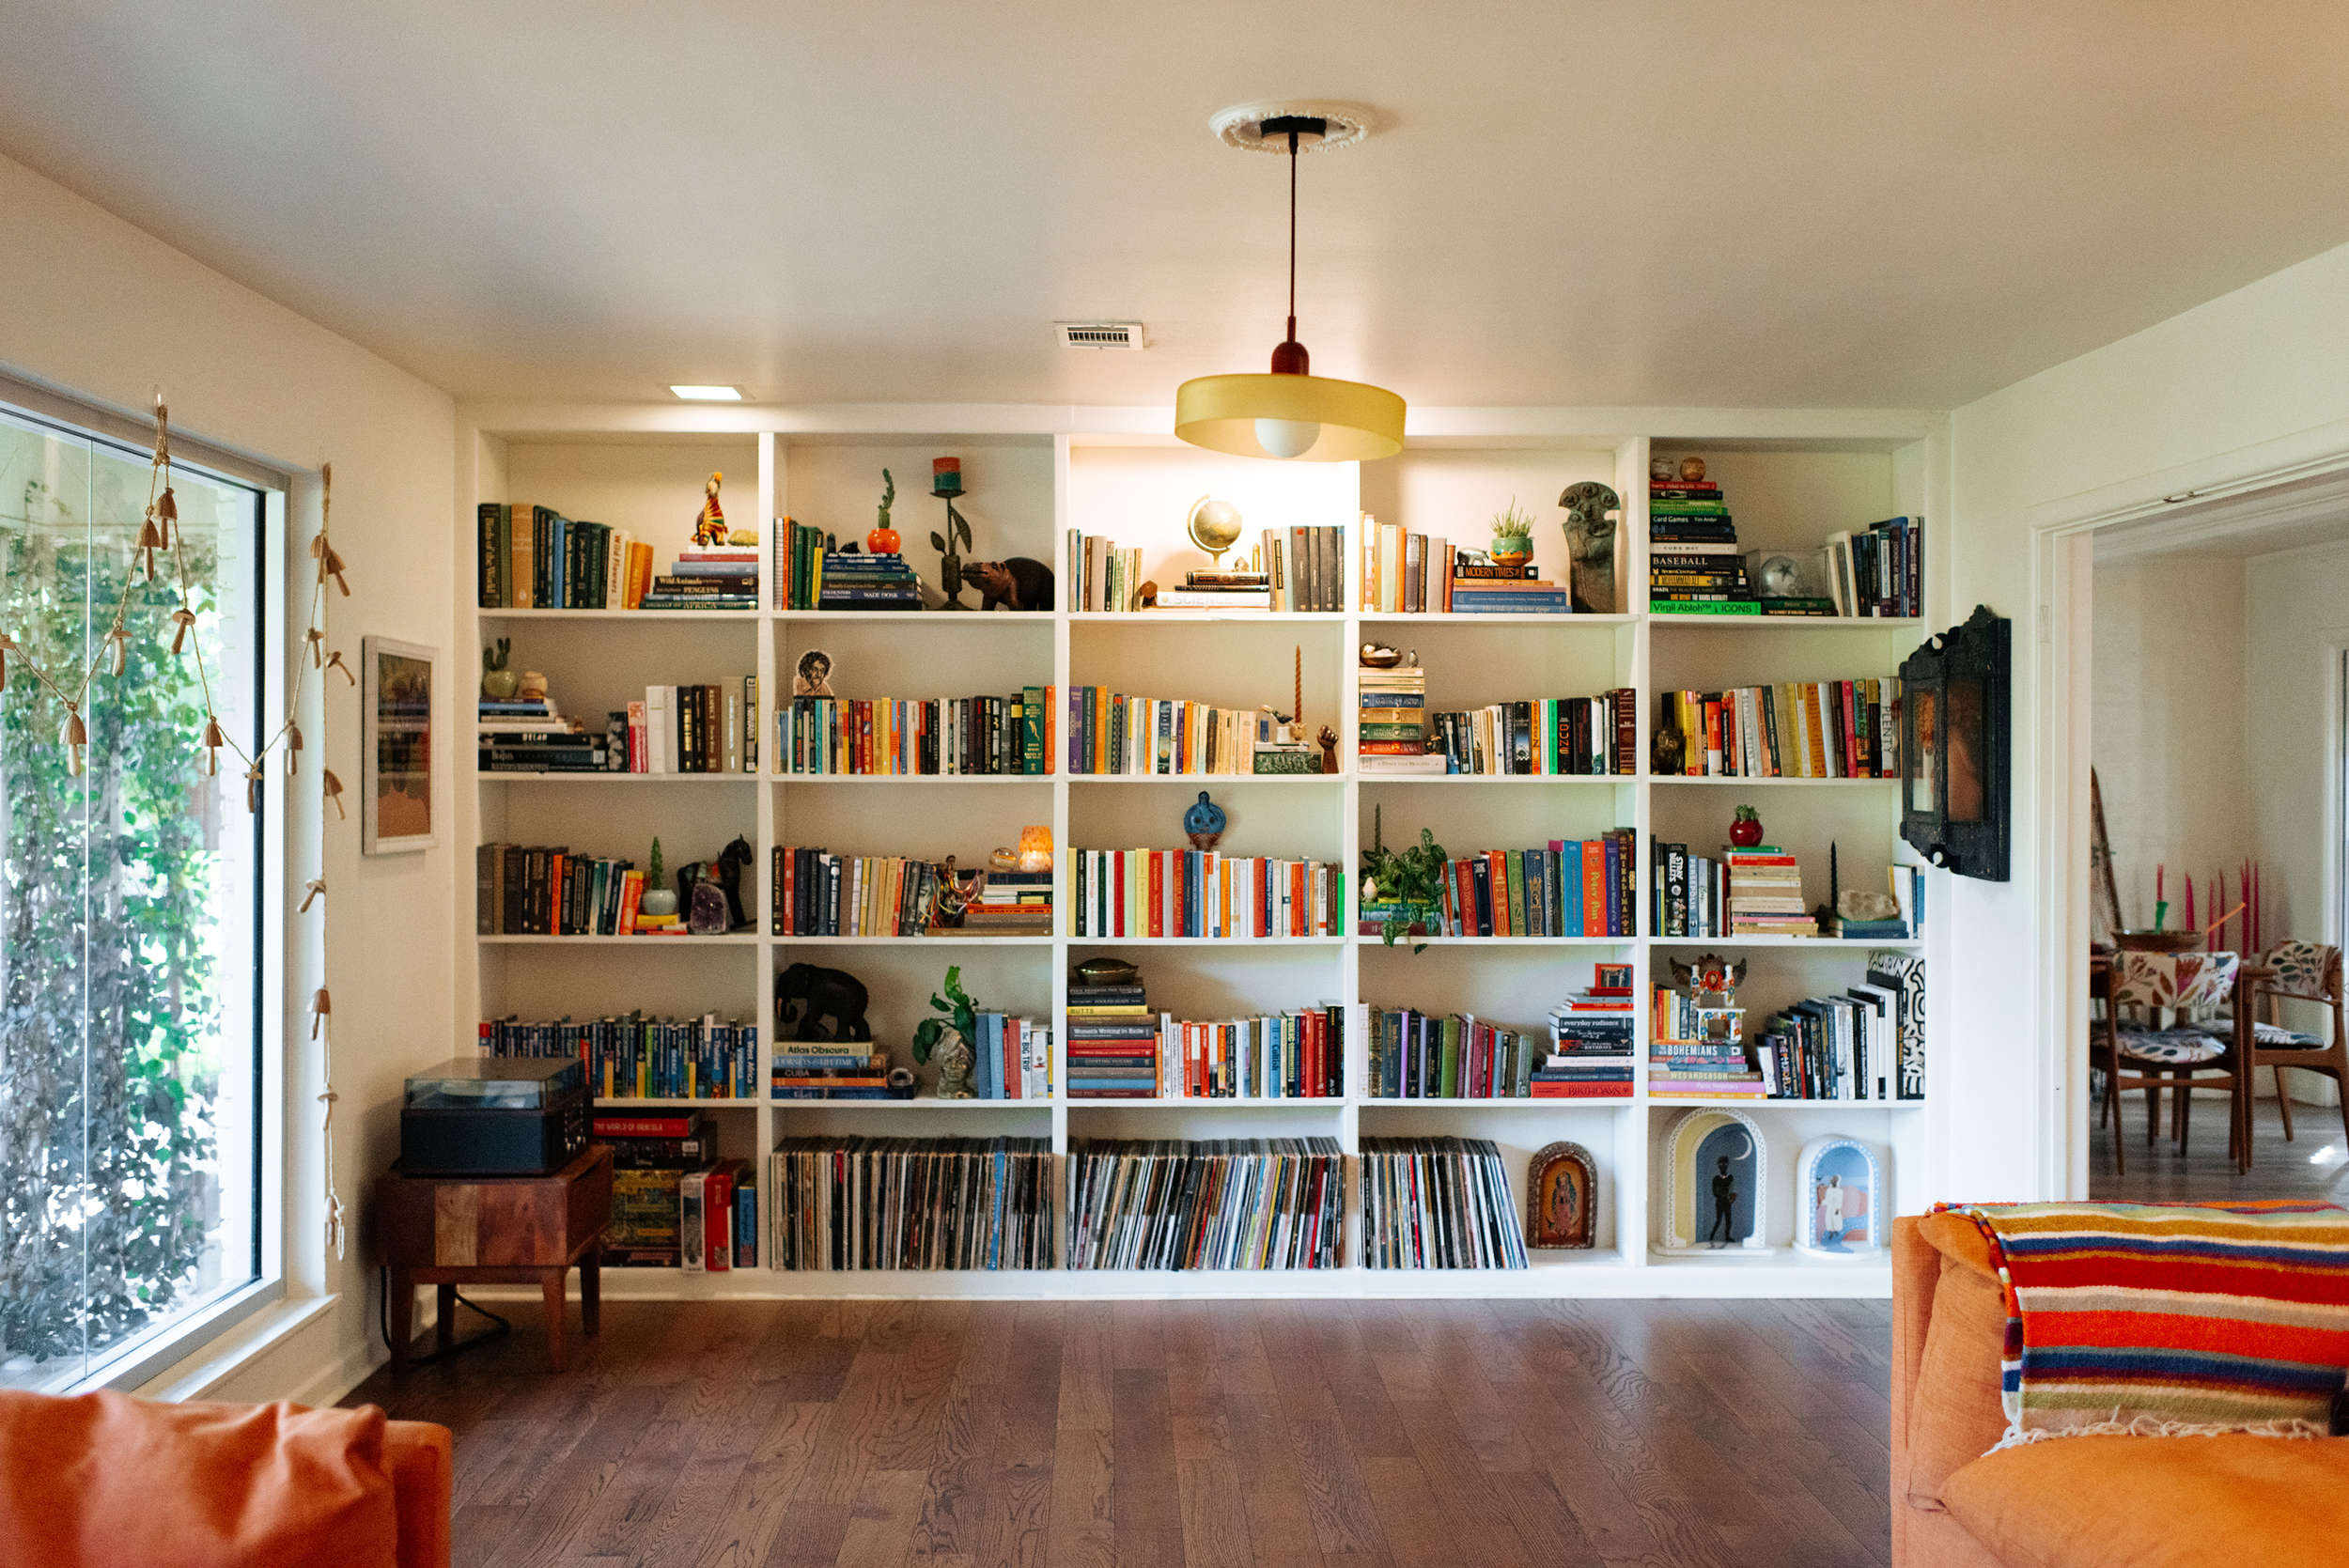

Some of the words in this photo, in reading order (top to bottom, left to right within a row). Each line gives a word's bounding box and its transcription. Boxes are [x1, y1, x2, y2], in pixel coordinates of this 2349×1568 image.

[486, 518, 495, 539] Birds
[486, 541, 495, 550] of
[486, 552, 495, 565] the
[1465, 567, 1493, 577] MODERN
[1494, 567, 1514, 577] TIMES
[486, 567, 495, 593] World
[1174, 594, 1232, 604] SCIENCE
[1652, 603, 1675, 613] Virgil
[1883, 706, 1892, 753] PLENTY
[1591, 871, 1600, 896] Peter
[1591, 901, 1600, 920] Pan
[787, 1046, 810, 1054] Atlas
[811, 1046, 849, 1054] Obscura
[1668, 1046, 1718, 1055] BOHEMIANS
[1568, 1086, 1621, 1095] BIRTHDAYS
